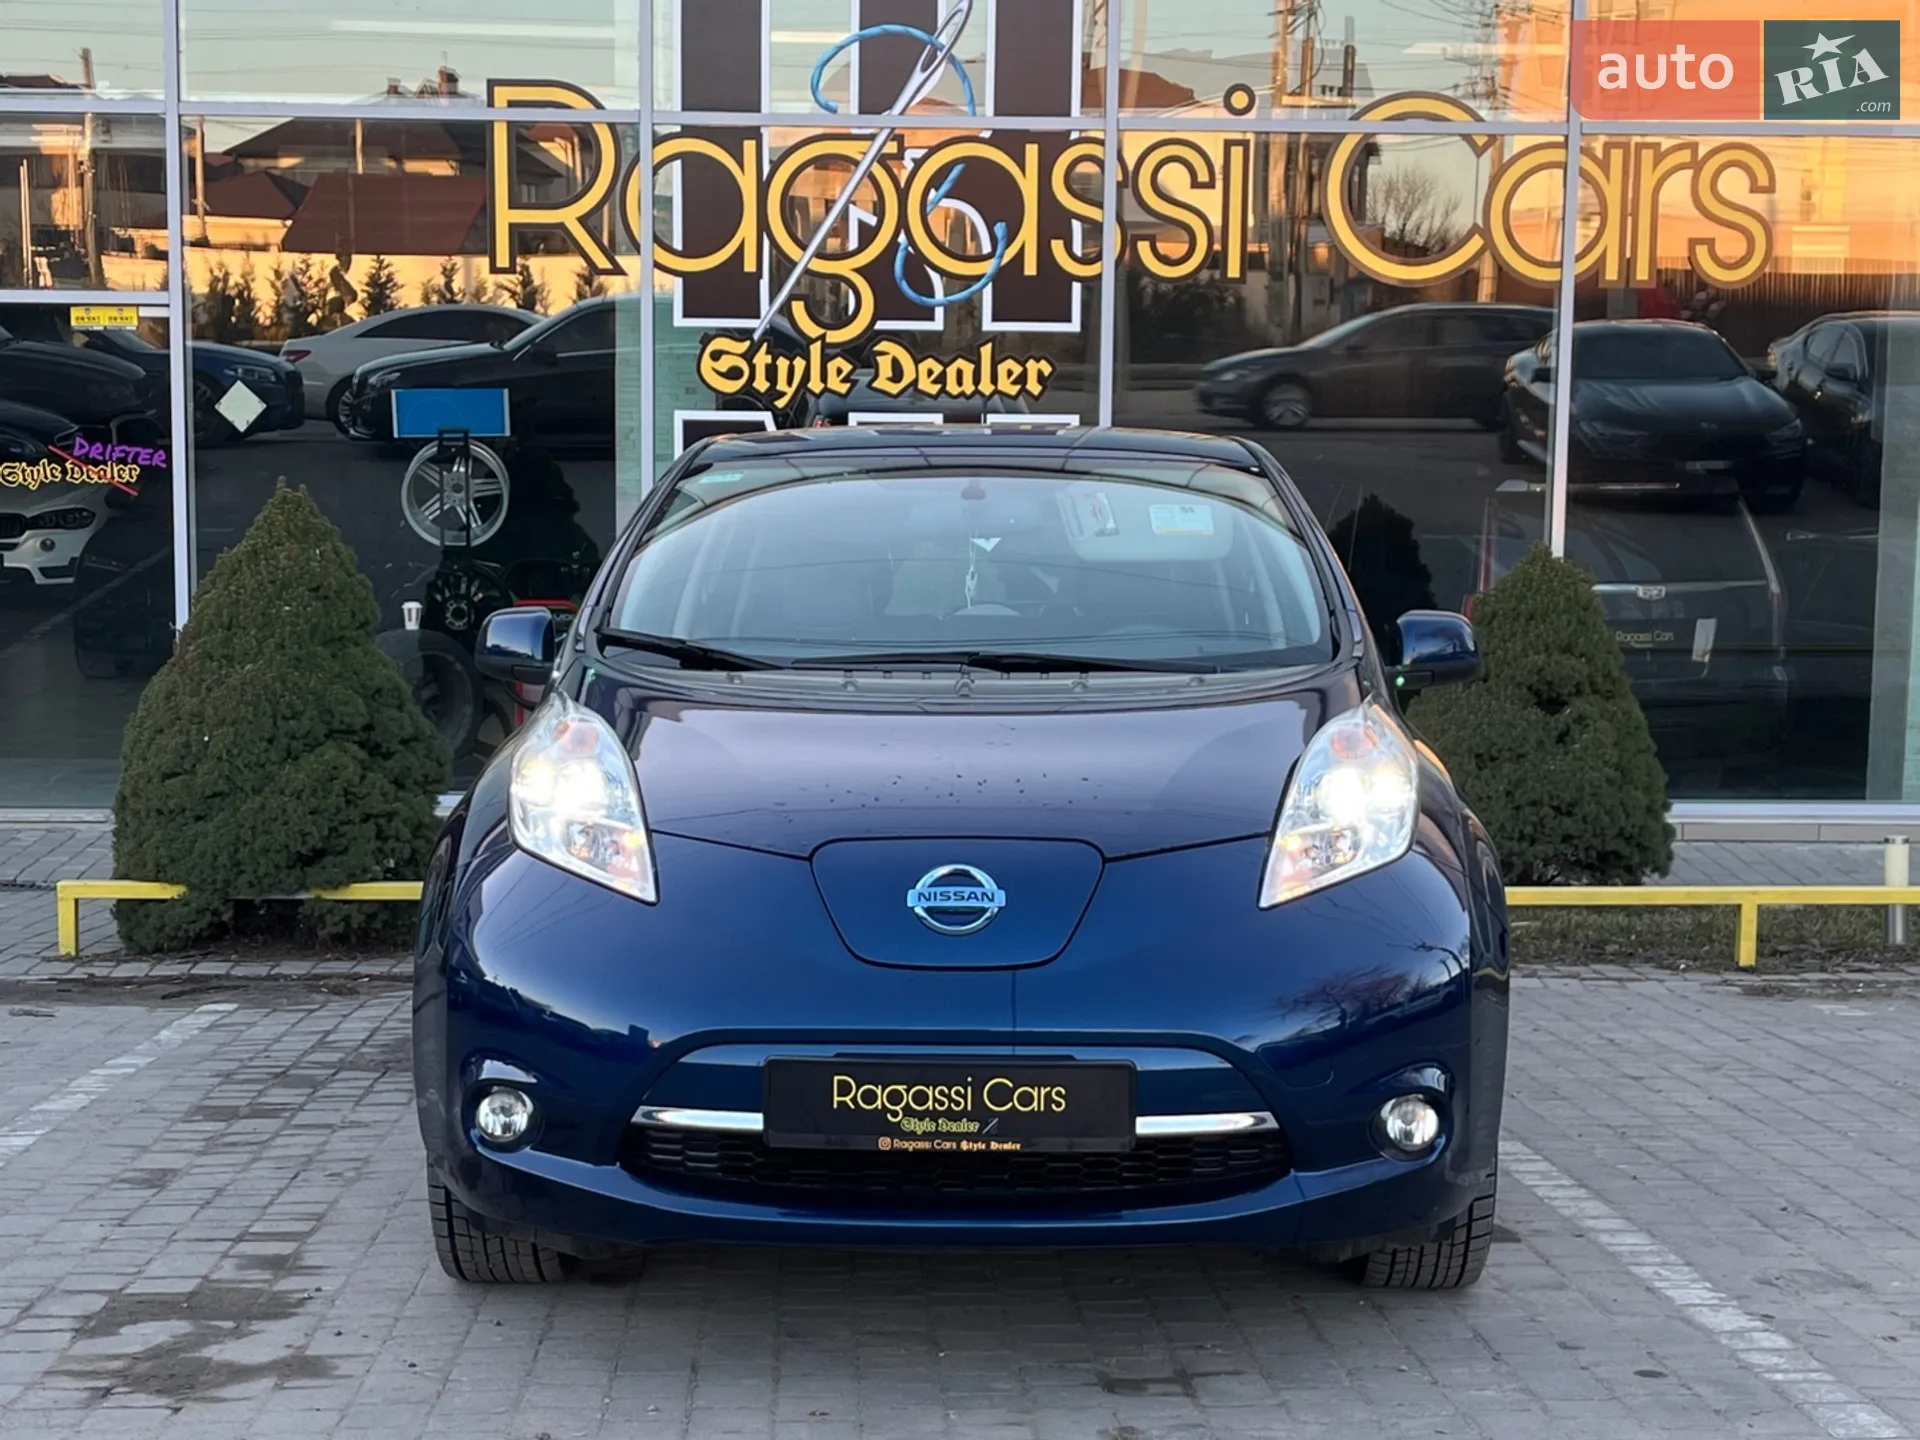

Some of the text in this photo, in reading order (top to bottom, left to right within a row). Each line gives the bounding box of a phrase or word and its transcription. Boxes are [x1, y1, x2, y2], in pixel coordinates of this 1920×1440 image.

[488, 79, 1776, 346] Ragassi Cars
[697, 332, 1056, 413] Style Dealer
[72, 435, 168, 468] DRIFTER
[0, 458, 141, 490] Style Dealer
[916, 890, 996, 904] NISSAN
[832, 1075, 1067, 1122] Ragassi Cars
[900, 1117, 981, 1135] Style Dealer
[893, 1138, 1022, 1151] Ragassi Cars Style Dealer
